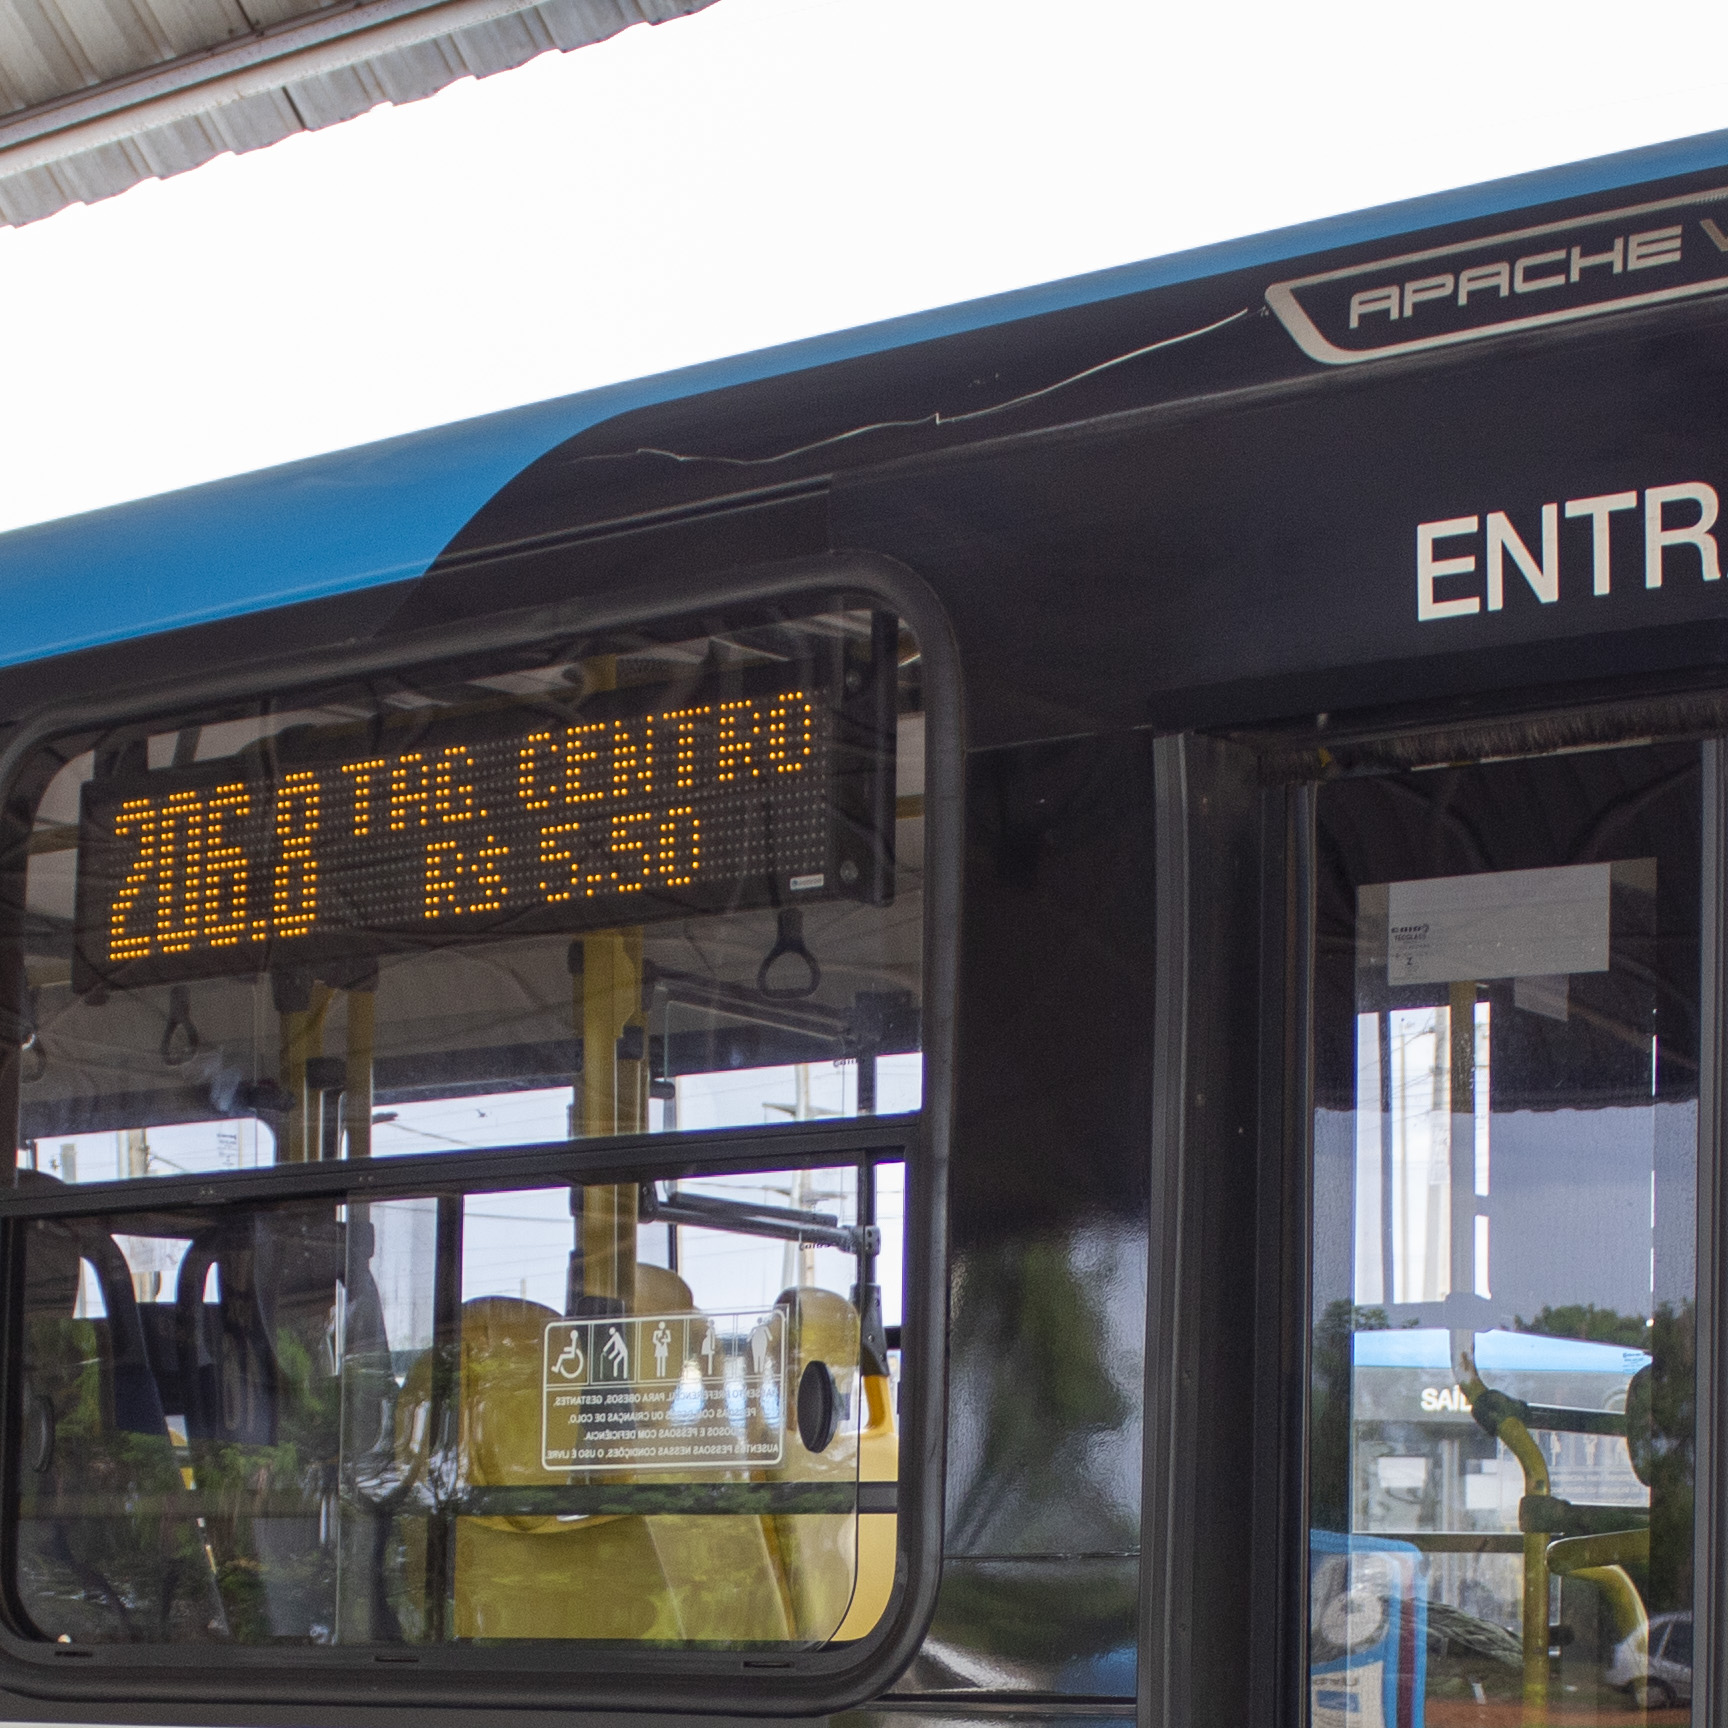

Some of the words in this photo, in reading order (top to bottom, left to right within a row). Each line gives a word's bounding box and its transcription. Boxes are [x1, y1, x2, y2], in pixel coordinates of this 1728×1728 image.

[1348, 223, 1683, 329] APACHE
[519, 691, 811, 809] CENTRO
[424, 835, 509, 919] R$
[540, 806, 700, 903] 5.50
